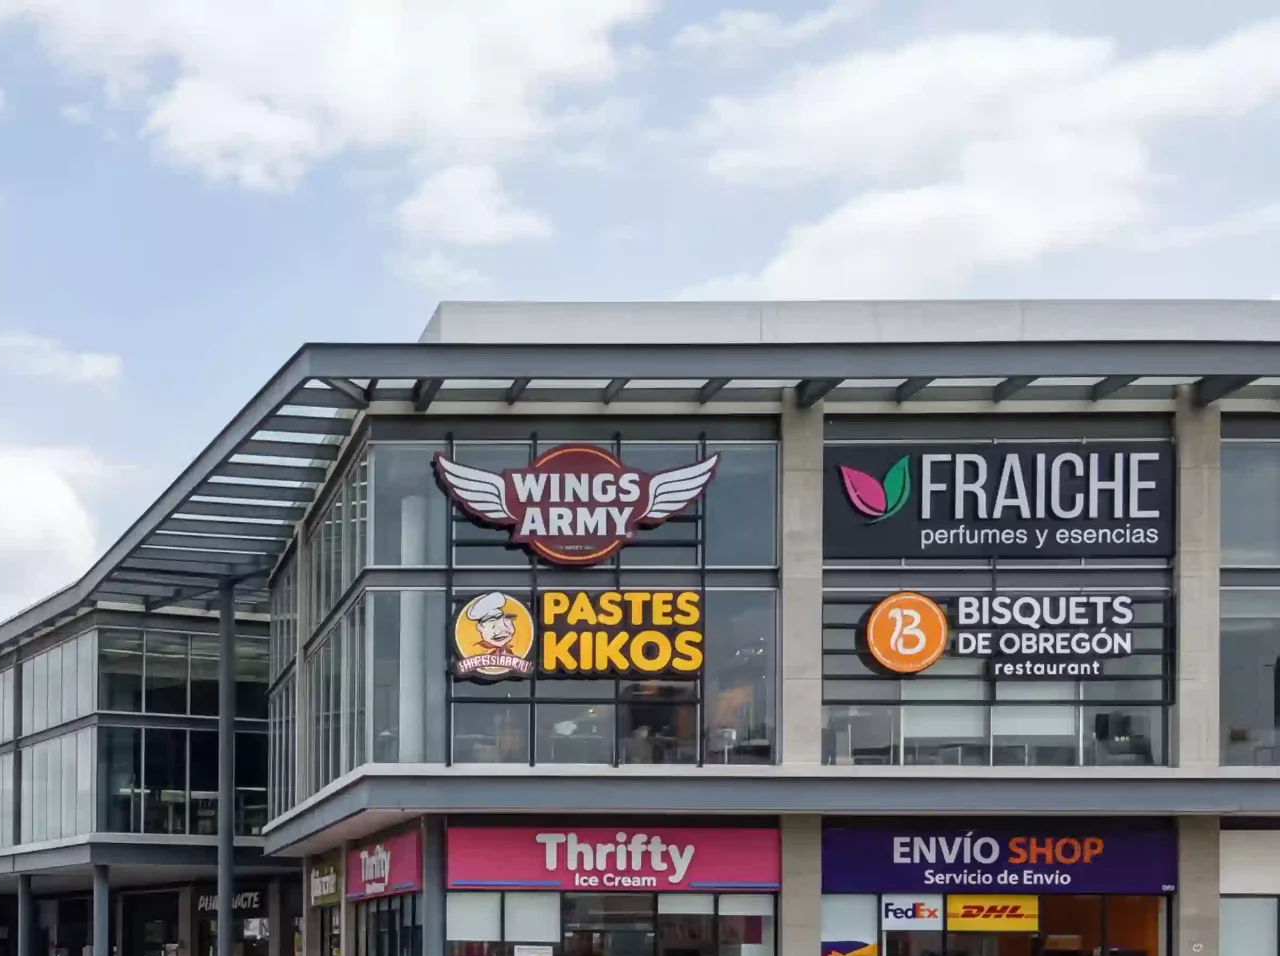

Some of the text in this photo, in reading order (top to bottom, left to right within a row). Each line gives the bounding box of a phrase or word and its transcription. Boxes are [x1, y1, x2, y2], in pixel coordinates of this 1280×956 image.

[511, 473, 641, 503] WINGS
[920, 452, 1161, 520] FRAICHE
[520, 506, 634, 536] ARMY
[921, 524, 1159, 549] perfumes y esencias
[543, 591, 700, 626] PASTES
[958, 596, 1133, 629] BISQUETS
[543, 630, 703, 672] KIKOS
[958, 627, 1132, 654] DE OBREGÓN
[994, 660, 1100, 675] restaurant
[535, 832, 695, 883] Thrifty
[893, 831, 1104, 865] ENVÍO SHOP
[574, 873, 656, 888] Ice Cream
[923, 869, 993, 885] Servicio
[997, 869, 1019, 885] de
[884, 903, 938, 919] FedEx
[960, 905, 1025, 918] DHL
